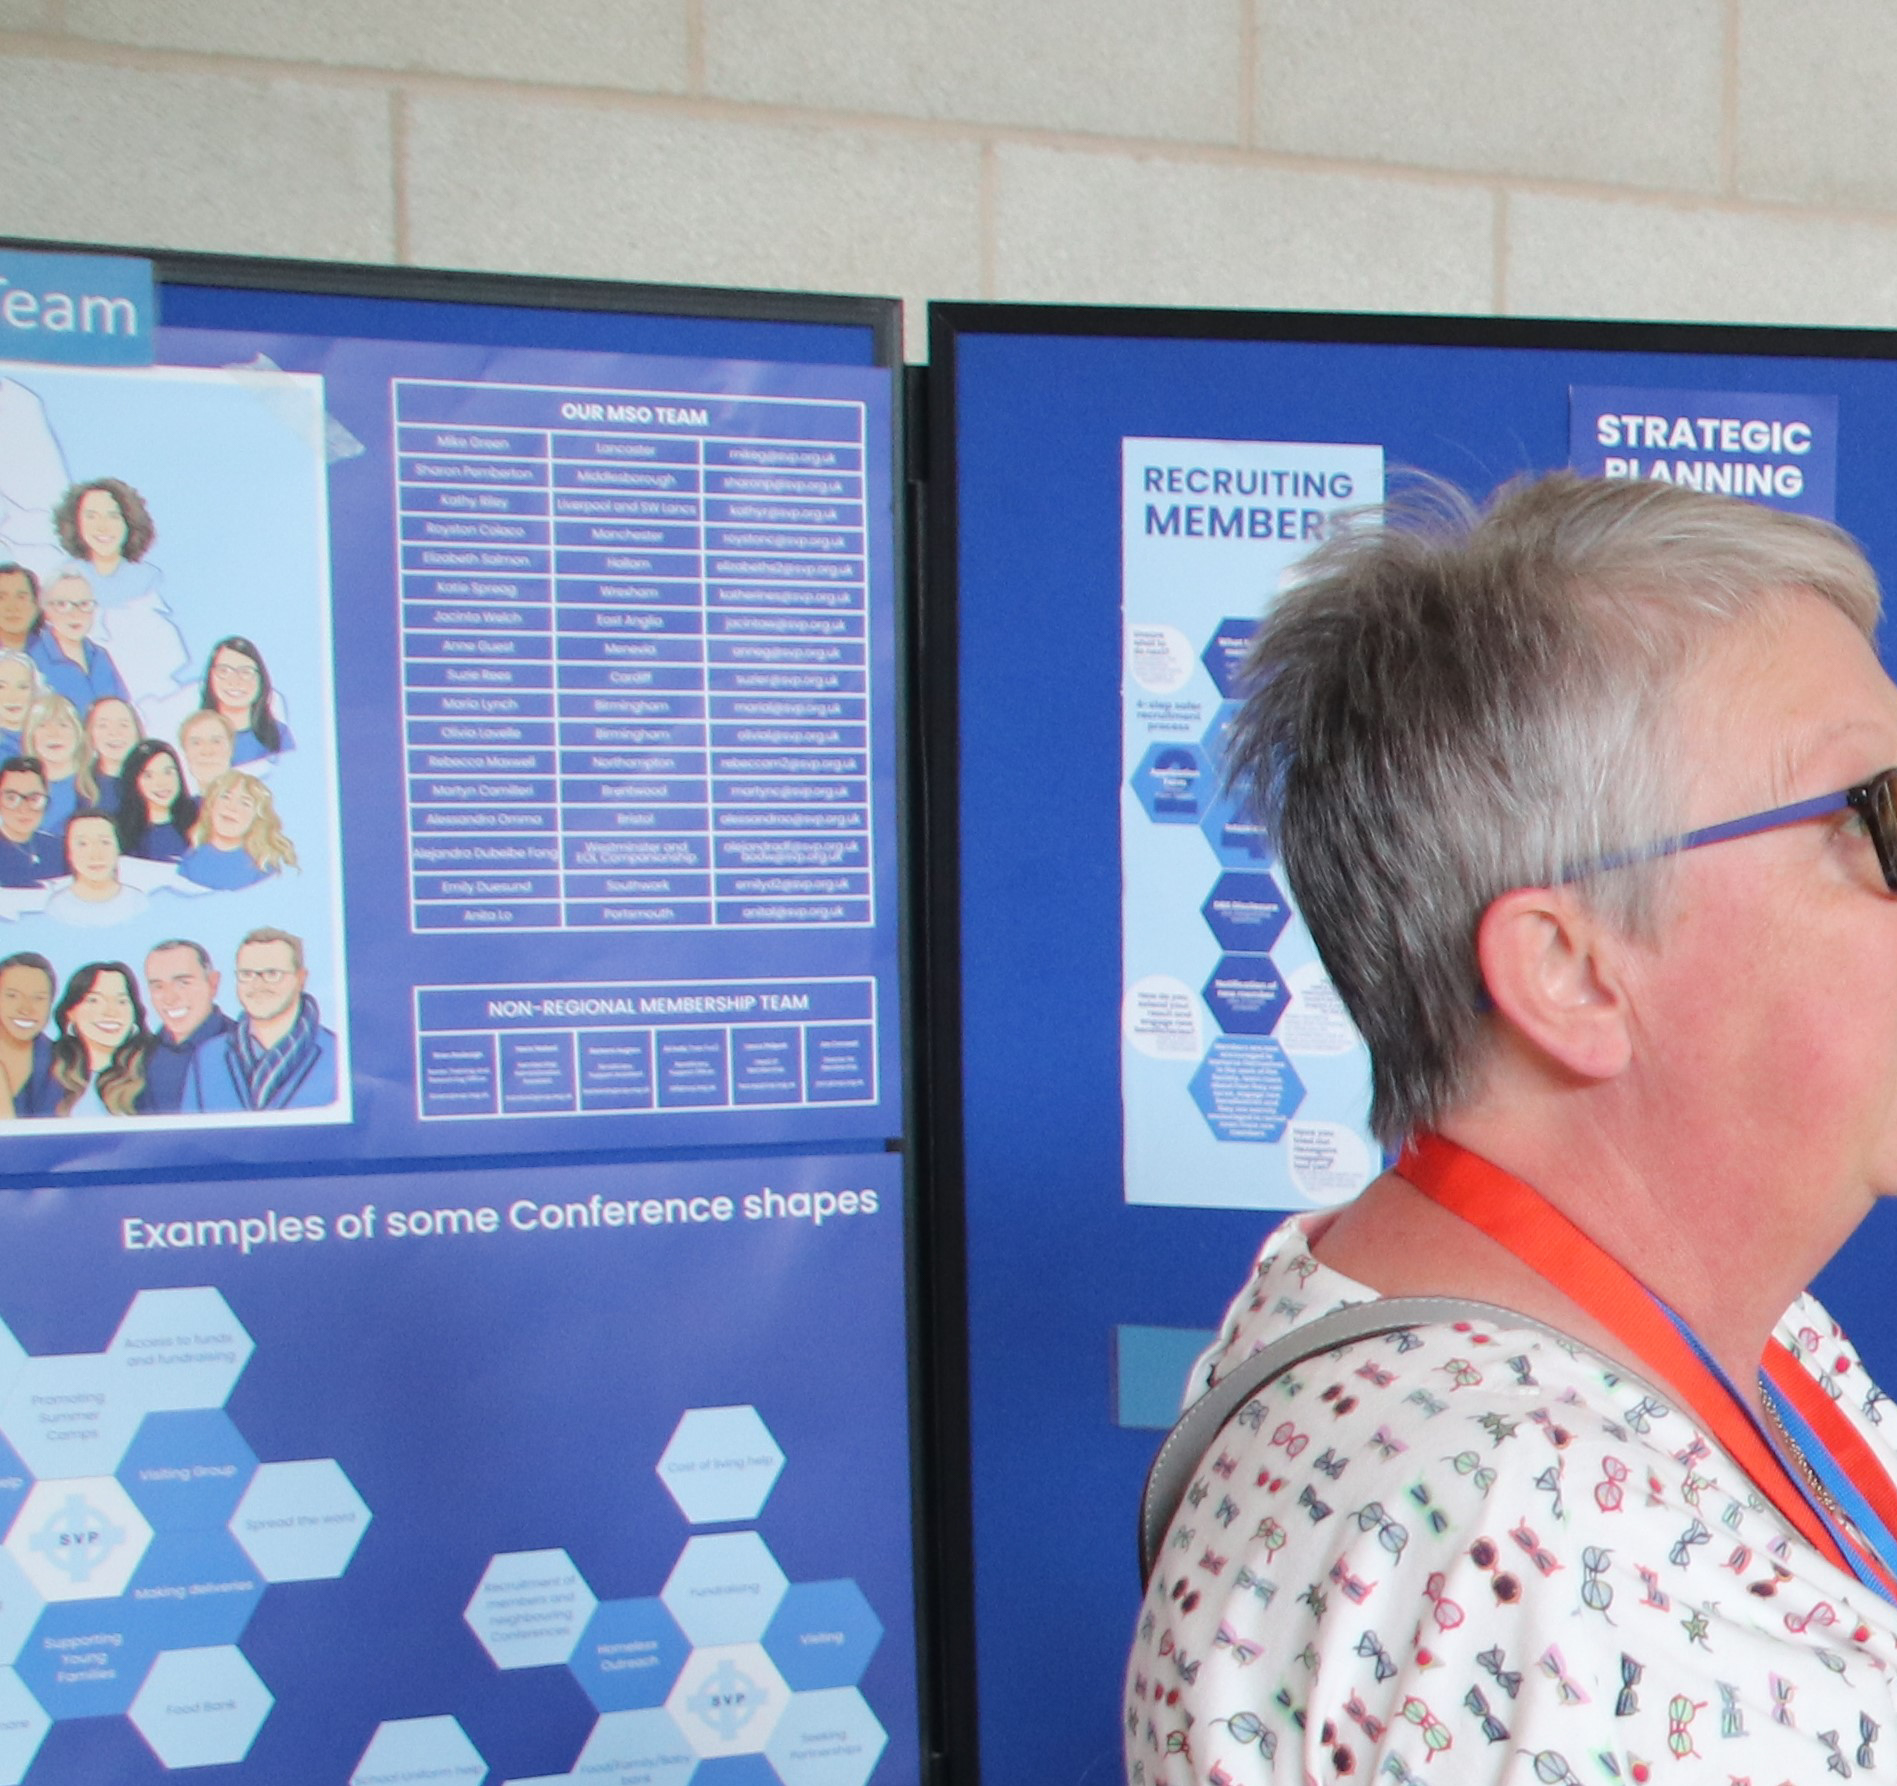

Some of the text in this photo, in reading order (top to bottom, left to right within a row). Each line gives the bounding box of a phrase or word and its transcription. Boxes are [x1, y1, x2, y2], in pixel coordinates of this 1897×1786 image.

[0, 268, 137, 336] eam
[562, 402, 709, 425] OUR MSO TEAM
[1597, 414, 1812, 454] STRATEGIC
[1144, 465, 1353, 498] RECRUITING
[1604, 457, 1805, 499] PLANNING
[1144, 503, 1340, 541] MEMBER
[593, 756, 674, 771] Northampton
[489, 993, 810, 1018] NON-REGIONAL MEMBERSHIP TEAM
[122, 1187, 879, 1253] Examples of some Conference shapes
[124, 1332, 232, 1349] Access to funds
[127, 1351, 236, 1367] and fundraising
[32, 1391, 106, 1409] Promoting
[39, 1410, 99, 1424] Summer
[47, 1428, 98, 1443] Camps
[668, 1453, 773, 1474] Cost of living help
[139, 1464, 237, 1482] Visiting Group
[246, 1511, 357, 1532] Spread the word
[59, 1531, 100, 1547] SVP
[134, 1581, 253, 1600] Making deliveries
[44, 1632, 123, 1651] Supporting
[597, 1639, 659, 1654] Homeless
[800, 1630, 845, 1647] Visiting
[62, 1652, 108, 1667] Young
[600, 1655, 659, 1672] Outreach
[57, 1668, 117, 1683] Families
[166, 1699, 236, 1716] Food Bank
[711, 1692, 745, 1706] SVP
[802, 1729, 847, 1744] Seeking
[790, 1742, 862, 1760] Partnerships
